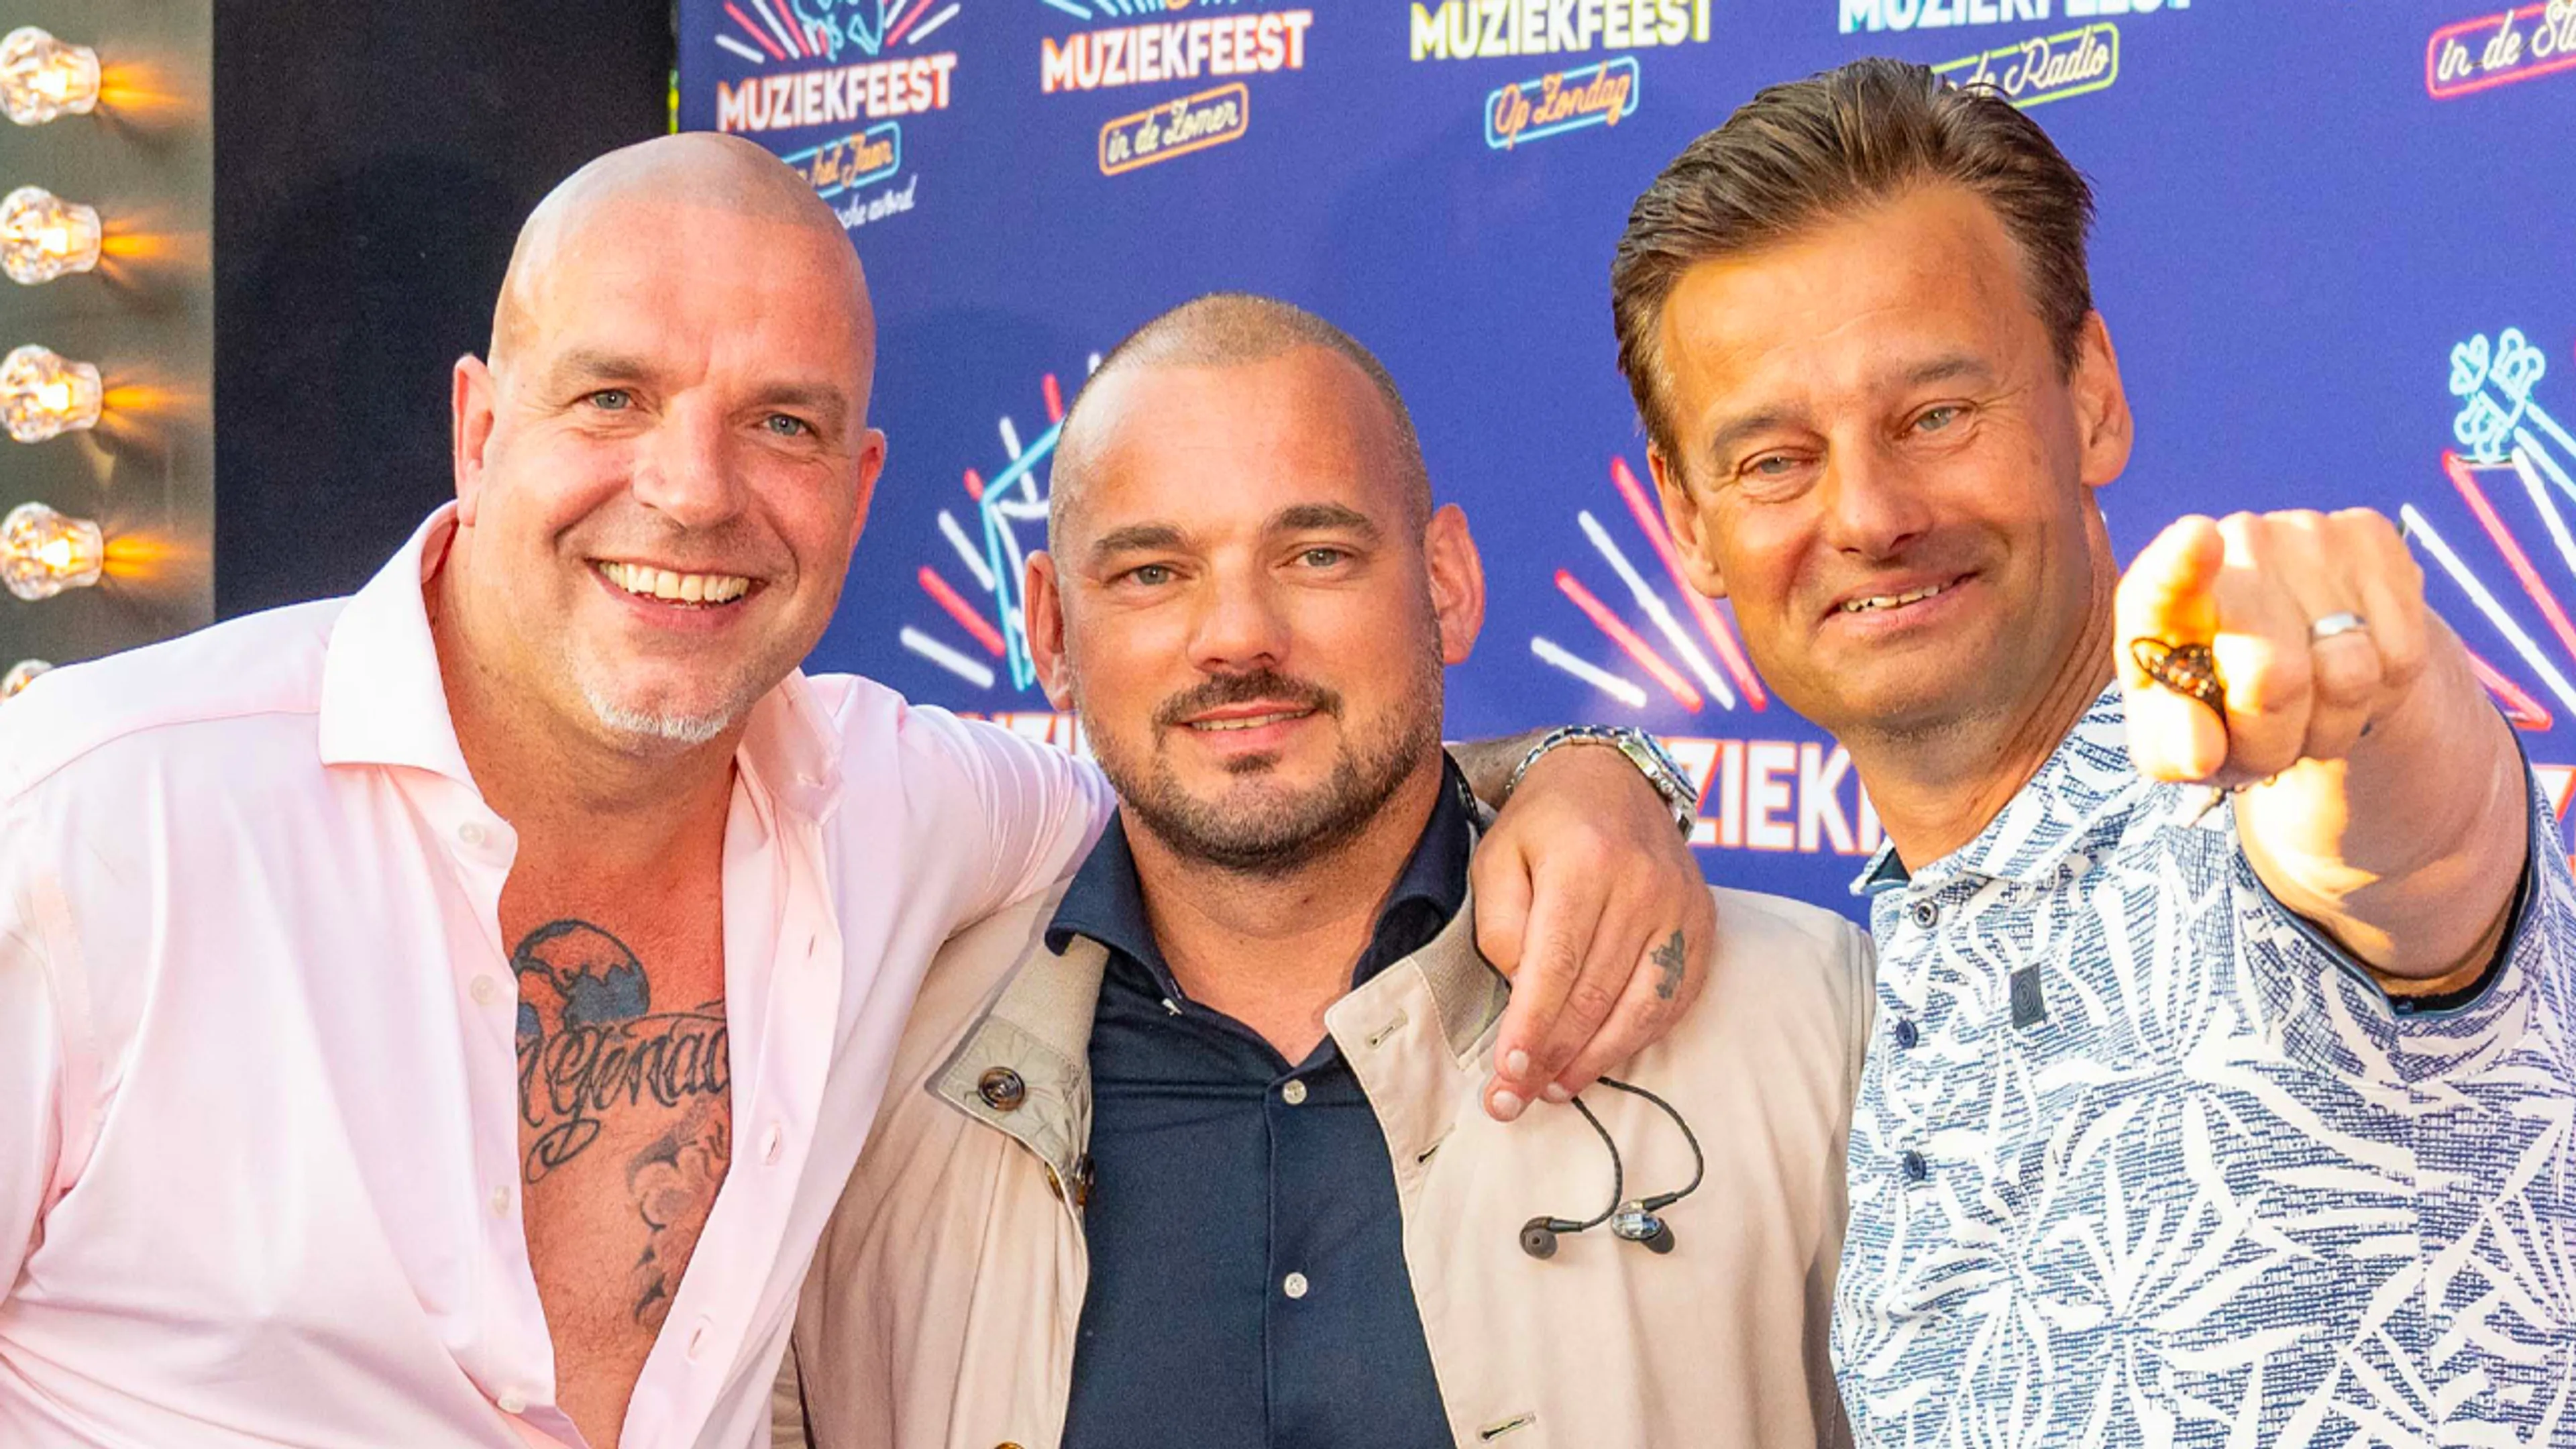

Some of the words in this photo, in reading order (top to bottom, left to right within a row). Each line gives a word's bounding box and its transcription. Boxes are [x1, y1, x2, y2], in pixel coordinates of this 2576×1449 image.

[1041, 9, 1313, 93] MUZIEKFEEST
[1409, 0, 1710, 62] MUZIEKFEEST
[2004, 24, 2109, 95] Radio
[2483, 9, 2521, 70] de
[717, 52, 957, 133] MUZIEKFEEST
[1134, 110, 1160, 155] de
[1163, 98, 1238, 146] Zomer
[1495, 83, 1530, 150] Op
[1532, 60, 1631, 127] Zondag
